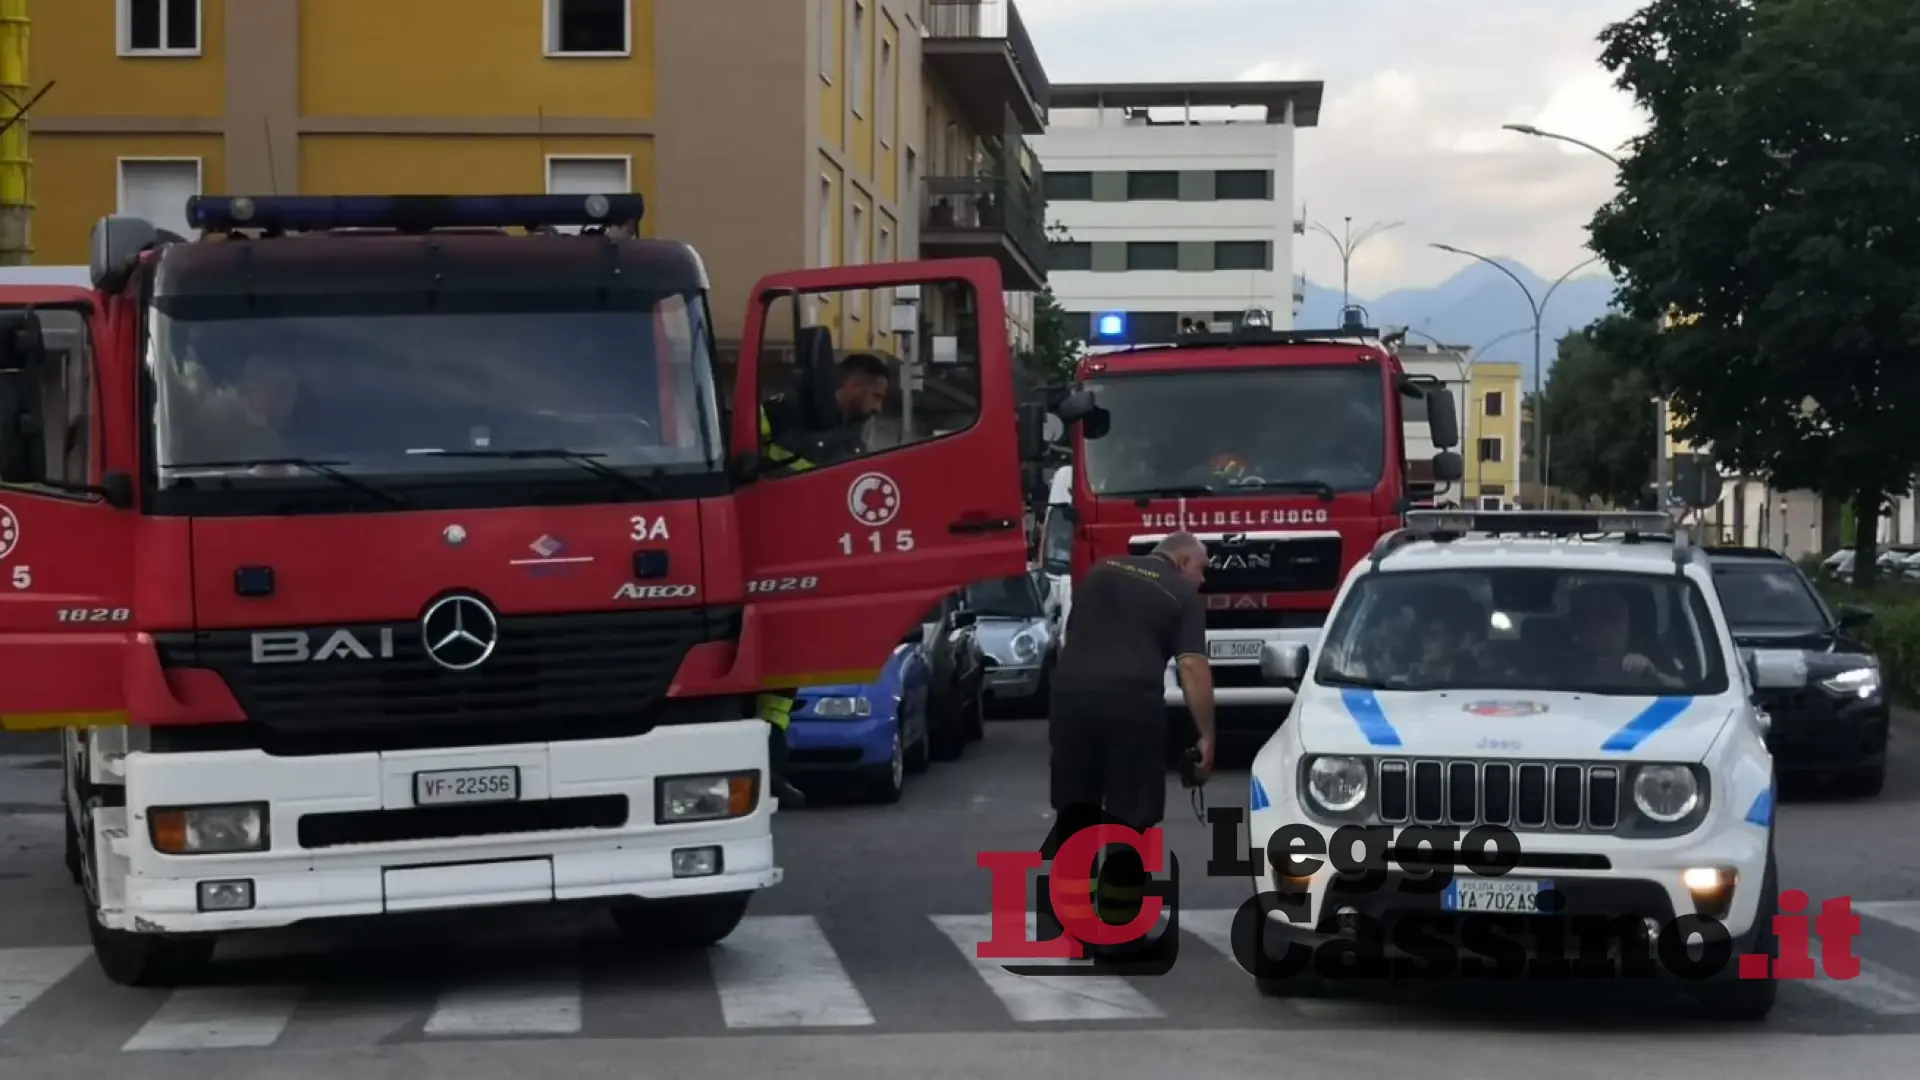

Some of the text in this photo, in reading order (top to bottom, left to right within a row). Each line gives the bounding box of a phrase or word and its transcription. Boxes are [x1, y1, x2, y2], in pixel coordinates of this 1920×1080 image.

[1214, 510, 1255, 525] DEL
[1260, 509, 1328, 524] FUOCO
[629, 515, 670, 542] 3A
[746, 576, 818, 593] 1828
[57, 607, 130, 622] 1828
[251, 627, 393, 663] BAI
